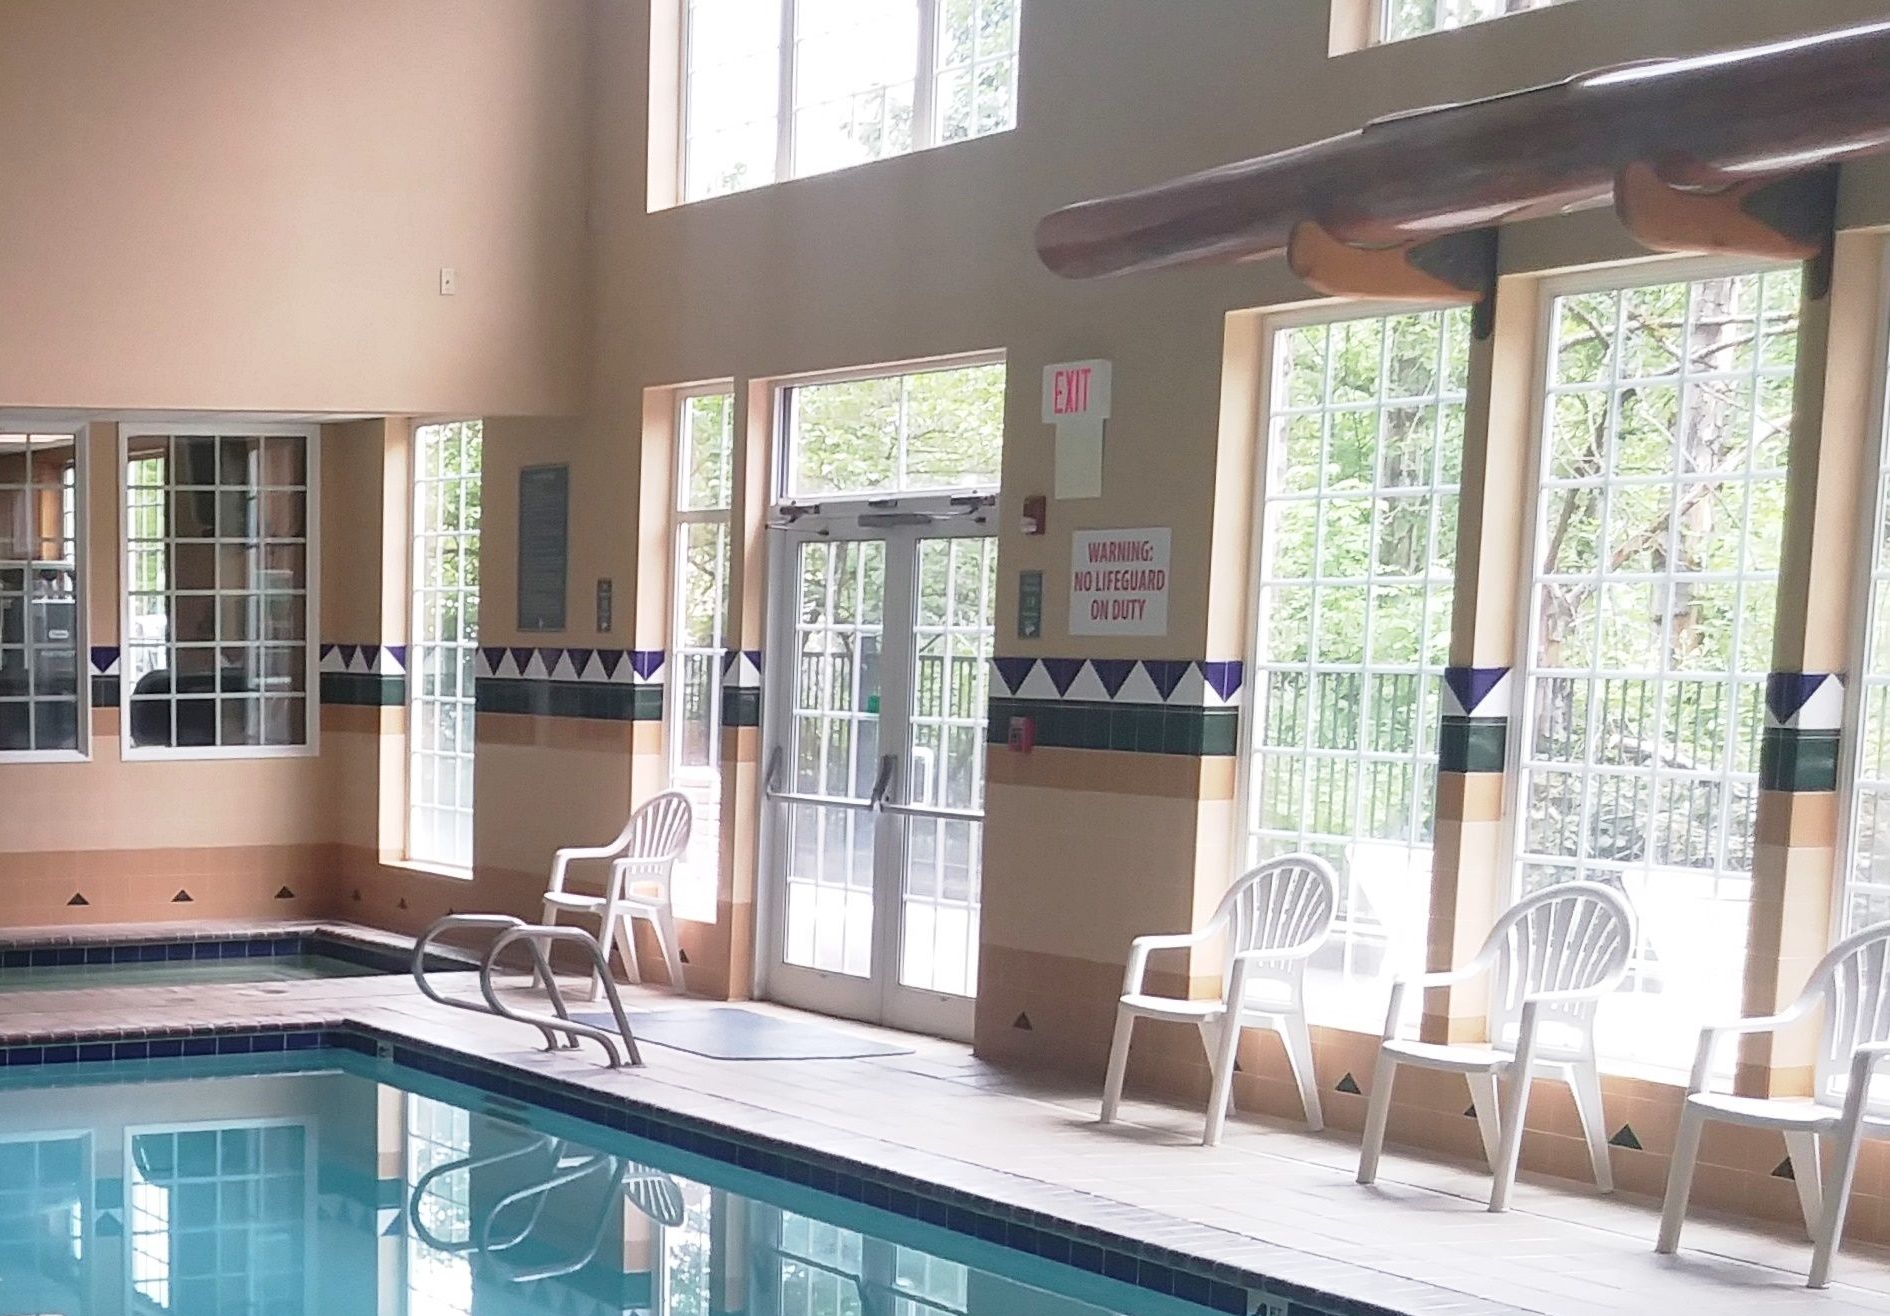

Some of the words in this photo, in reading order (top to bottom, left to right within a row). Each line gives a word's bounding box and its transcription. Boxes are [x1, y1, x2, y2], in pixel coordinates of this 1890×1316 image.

[1053, 367, 1092, 414] EXIT
[1088, 540, 1153, 563] WARNING:
[1074, 570, 1093, 592] NO
[1095, 569, 1166, 592] LIFEGUARD
[1091, 599, 1109, 620] ON
[1112, 598, 1146, 620] DUTY
